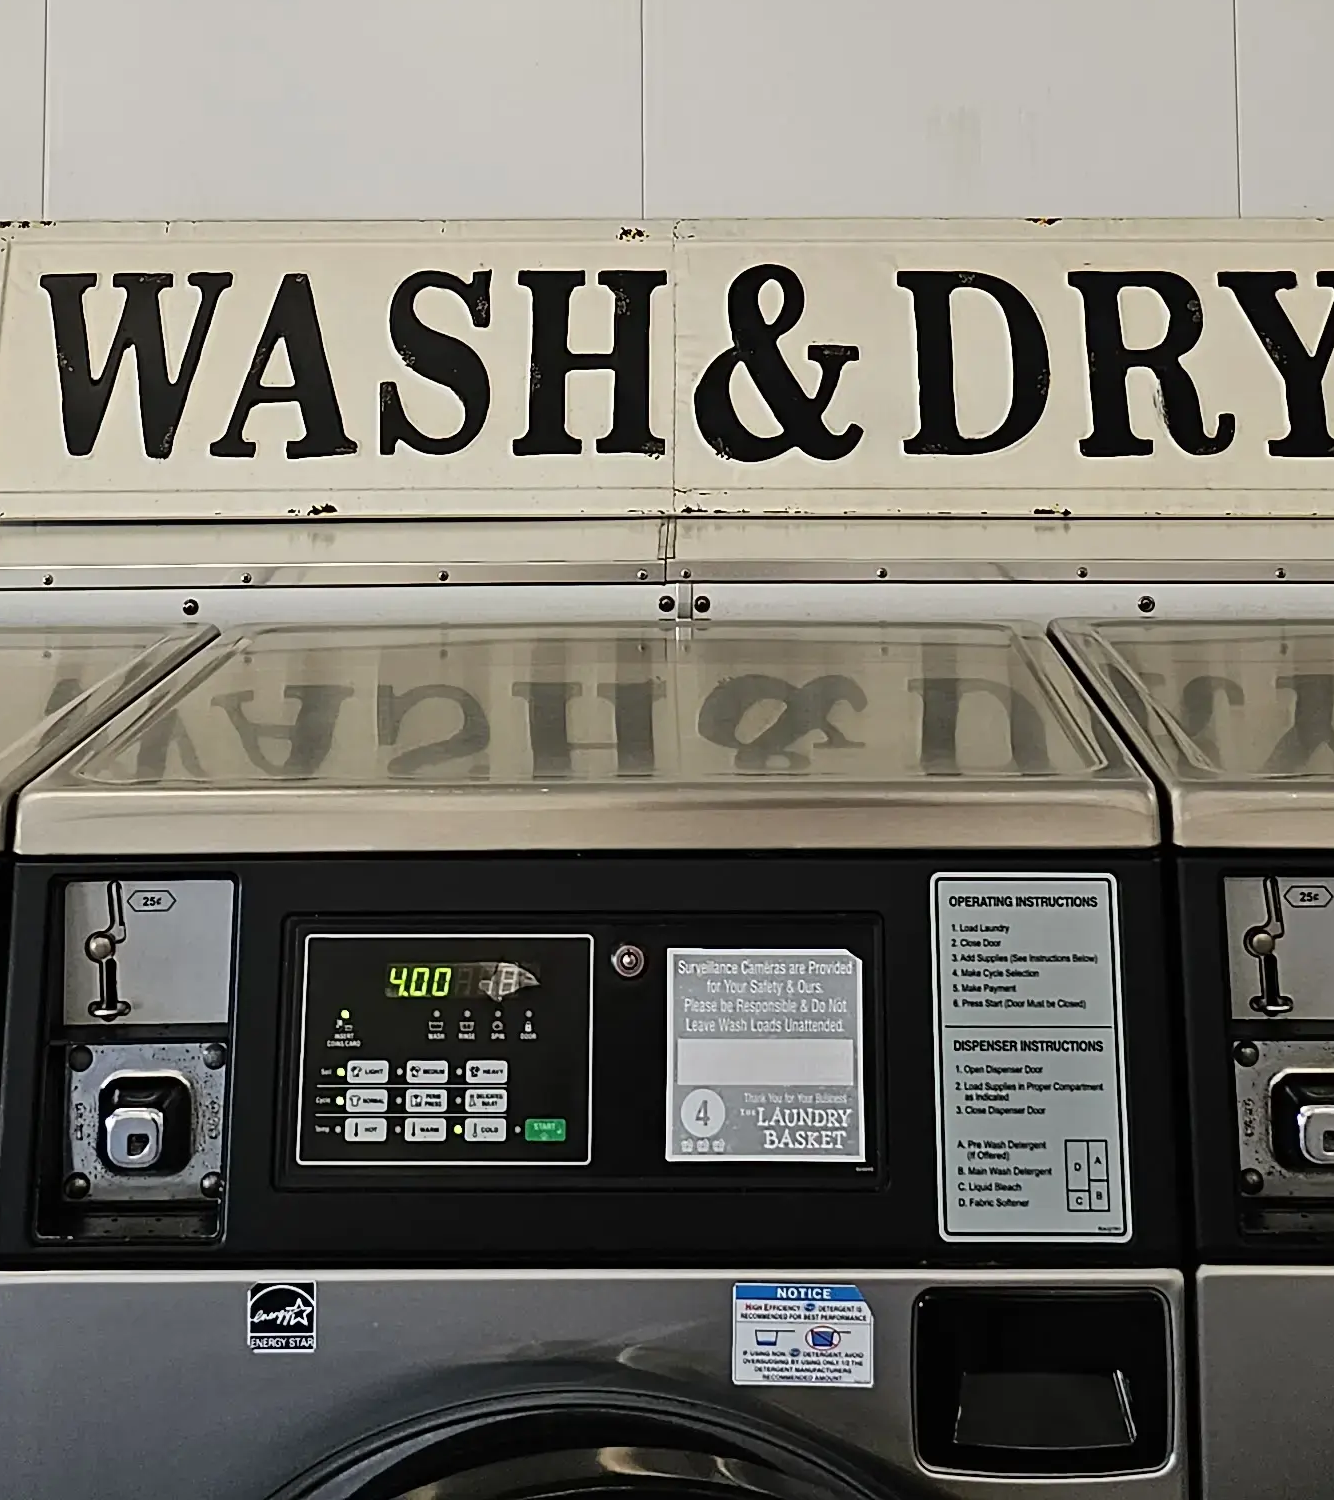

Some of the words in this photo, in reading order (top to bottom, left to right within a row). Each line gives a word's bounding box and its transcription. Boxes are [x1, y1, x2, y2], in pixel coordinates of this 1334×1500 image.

[142, 897, 162, 907] 25¢
[949, 896, 1013, 907] OPERATING
[1016, 896, 1098, 907] INSTRUCTIONS
[960, 924, 978, 932] Load
[980, 925, 1009, 934] Laundry
[960, 939, 981, 947] Close
[983, 939, 1001, 947] Door
[960, 954, 975, 962] Add
[977, 954, 1008, 963] Supplies
[1029, 954, 1071, 962] Instructions
[678, 960, 738, 975] Surveillance
[741, 961, 786, 974] Cameras
[789, 964, 806, 974] are
[808, 961, 852, 974] Provided
[389, 967, 451, 997] 4.00
[707, 980, 721, 993] for
[724, 980, 747, 993] Your
[750, 980, 783, 995] Safety
[984, 985, 1016, 994] Payment
[684, 999, 717, 1012] Please
[720, 1000, 733, 1012] be
[736, 999, 796, 1014] Responsible
[811, 1000, 826, 1012] Do
[829, 1000, 847, 1012] Not
[962, 1000, 983, 1008] Press
[985, 1000, 1003, 1008] Start
[686, 1019, 716, 1032] Leave
[719, 1019, 747, 1032] Wash
[750, 1019, 781, 1032] Loads
[954, 1040, 1017, 1052] DISPENSER
[1021, 1041, 1104, 1052] INSTRUCTIONS
[695, 1100, 710, 1126] 4
[757, 1107, 853, 1127] LAUNDRY
[764, 1129, 847, 1149] BASKET
[1074, 1163, 1081, 1171] D
[1076, 1197, 1083, 1205] C
[1096, 1192, 1102, 1200] B
[777, 1288, 831, 1299] NOTICE
[250, 1338, 287, 1348] ENERGY
[289, 1338, 313, 1347] STAR
